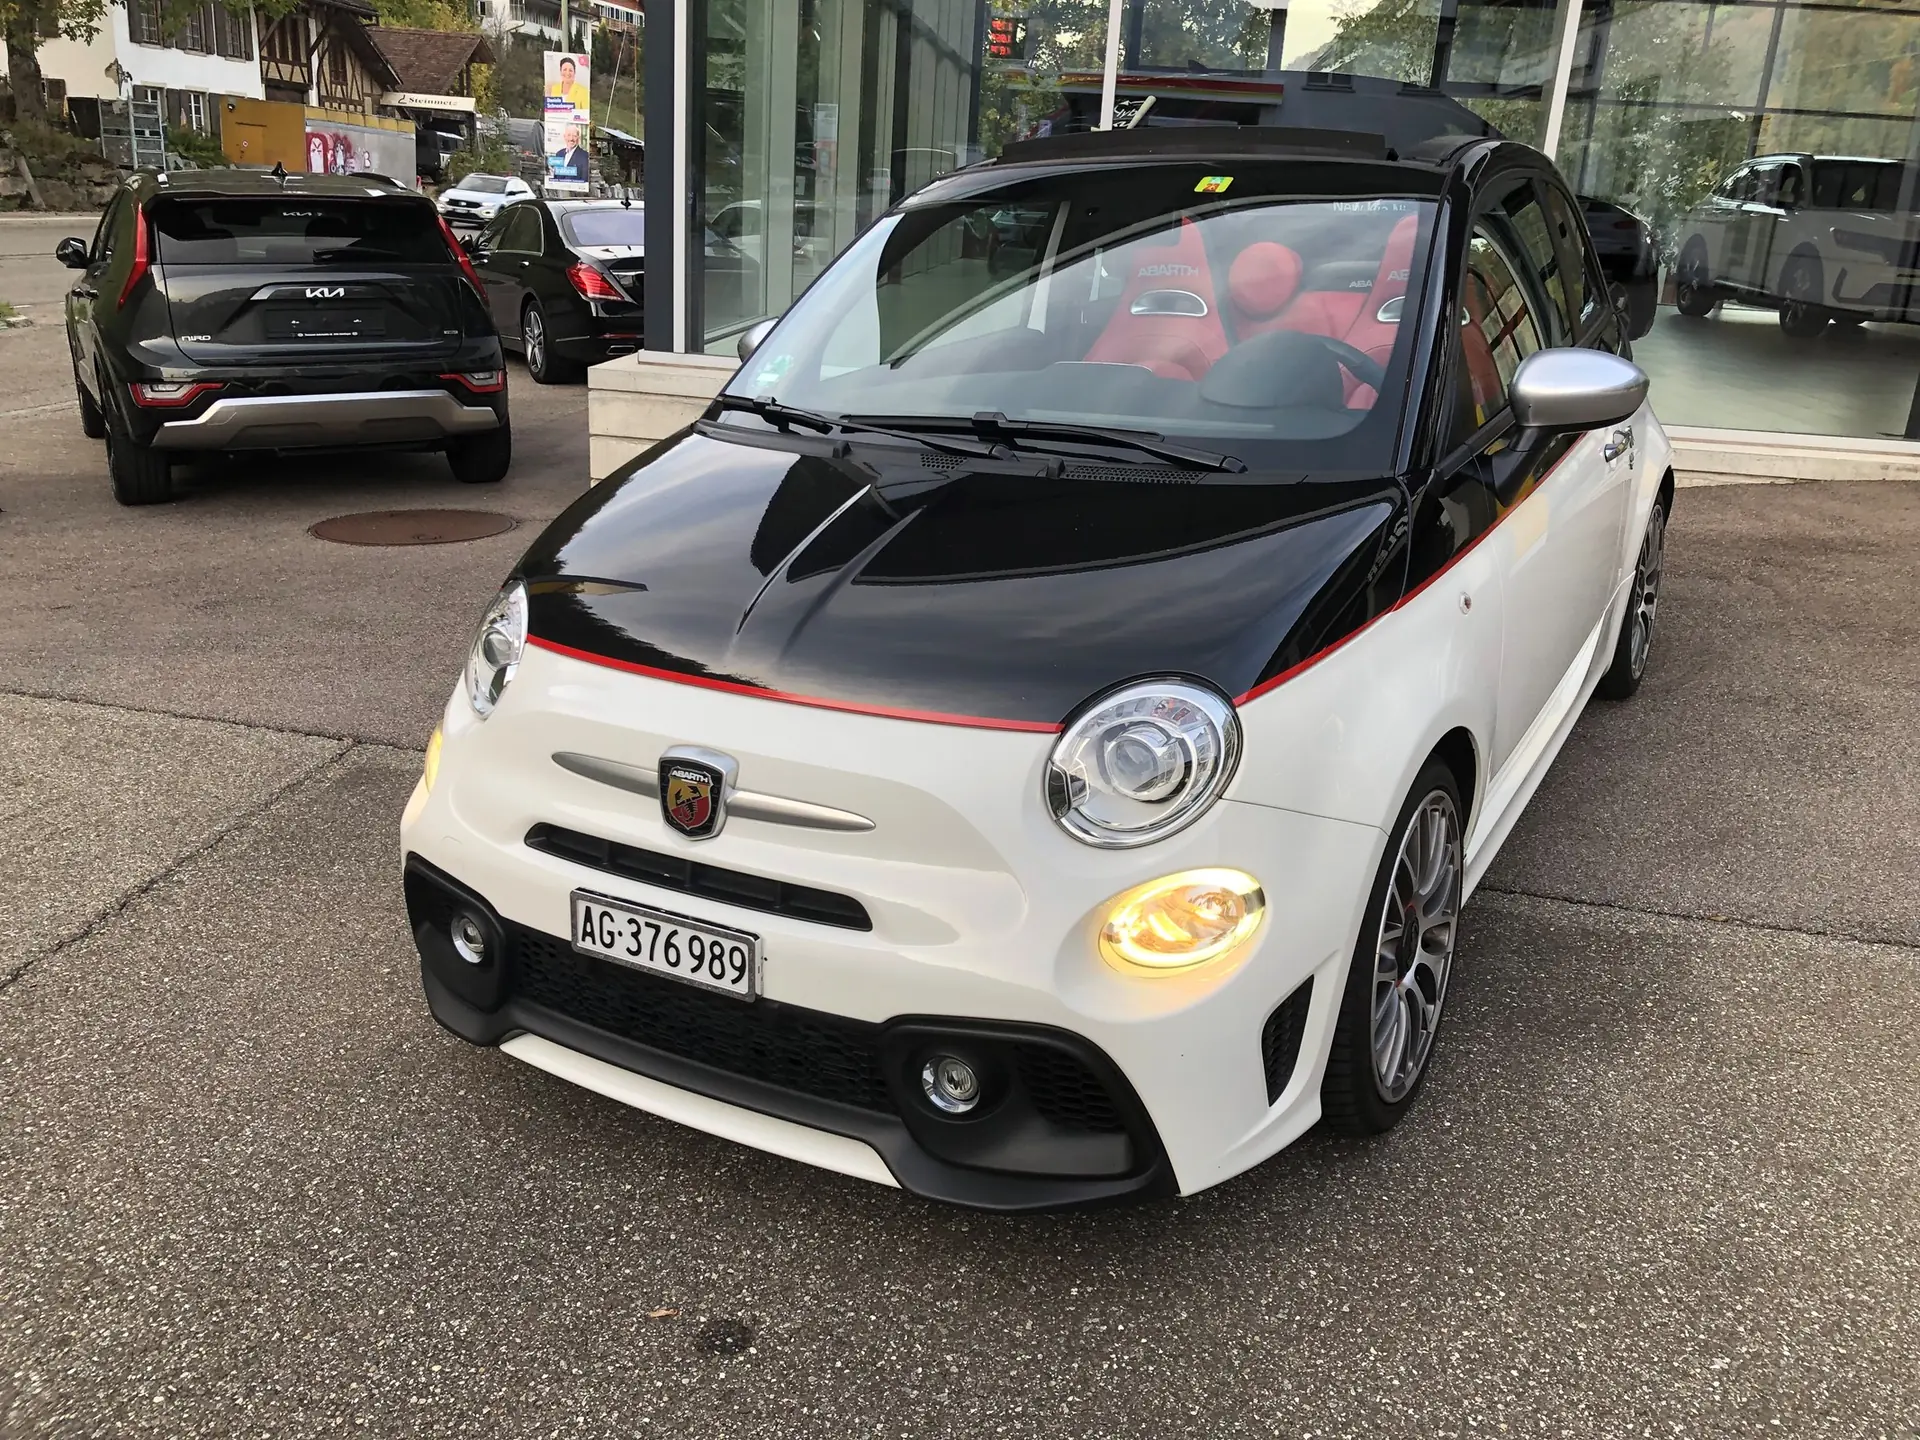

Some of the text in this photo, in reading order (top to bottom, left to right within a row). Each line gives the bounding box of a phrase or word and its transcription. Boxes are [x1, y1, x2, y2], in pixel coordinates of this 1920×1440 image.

[1137, 263, 1199, 278] ABARTH
[305, 287, 345, 298] KIA
[671, 769, 709, 783] ABARTH
